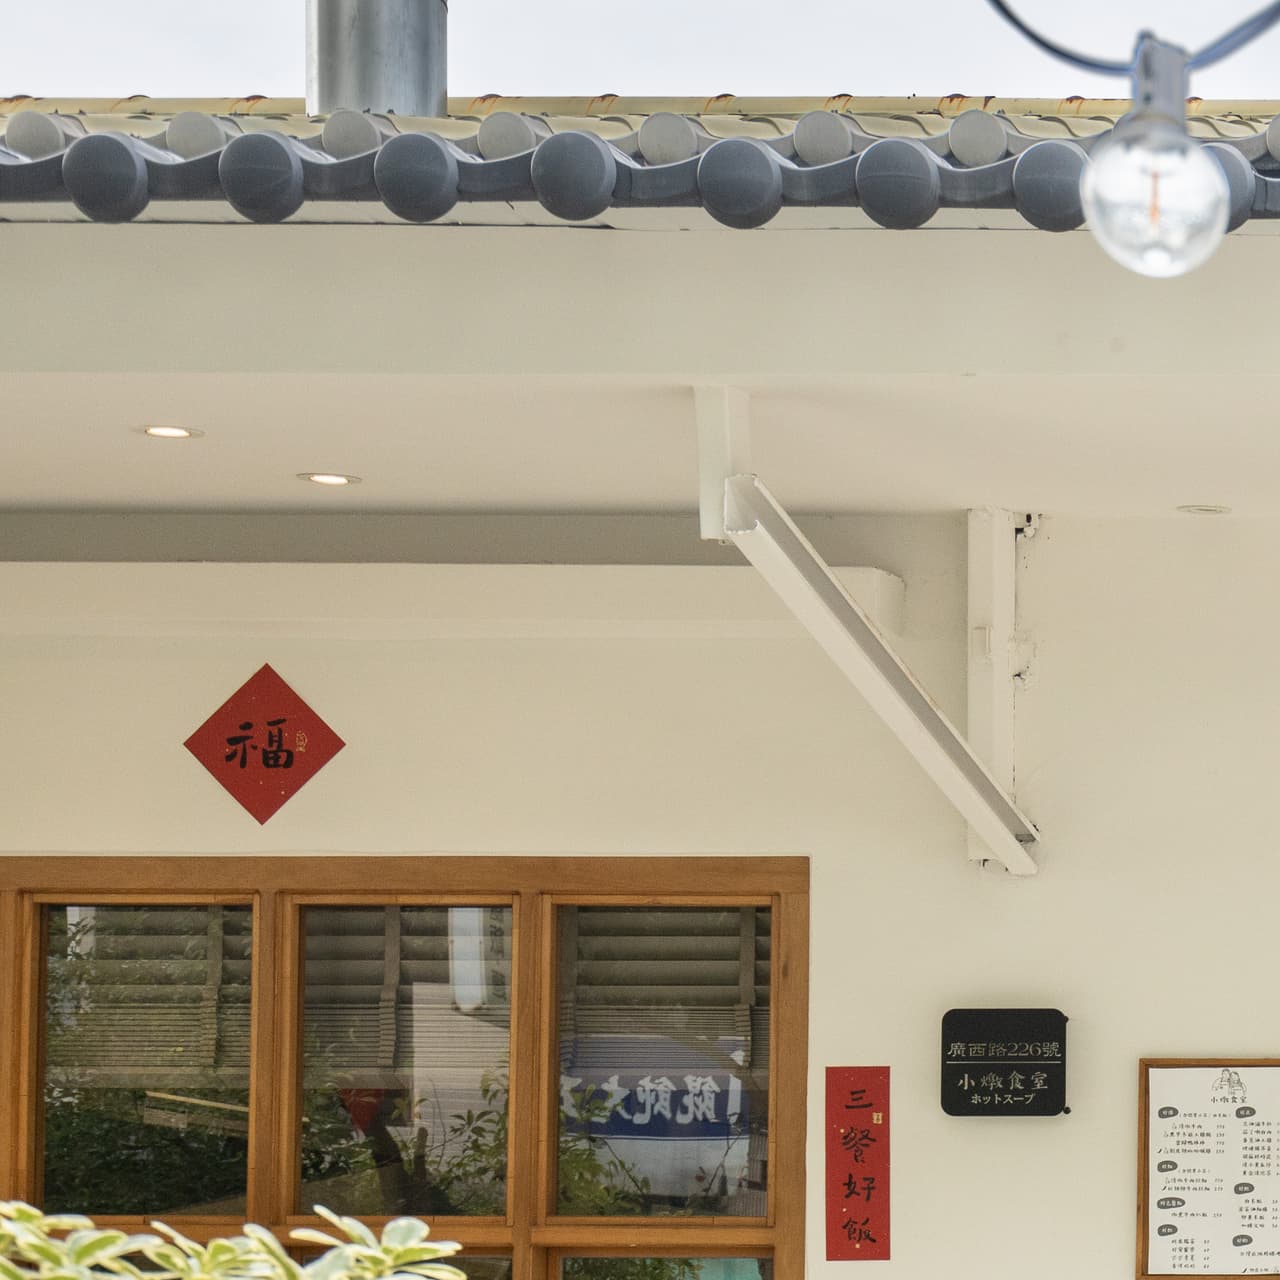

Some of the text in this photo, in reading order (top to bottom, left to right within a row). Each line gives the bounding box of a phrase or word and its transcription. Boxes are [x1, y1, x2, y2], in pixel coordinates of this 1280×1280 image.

[224, 718, 294, 768] 福
[947, 1042, 1062, 1057] 廣西路226號
[957, 1071, 1048, 1091] 小燉食室
[841, 1089, 877, 1244] 三餐好飯
